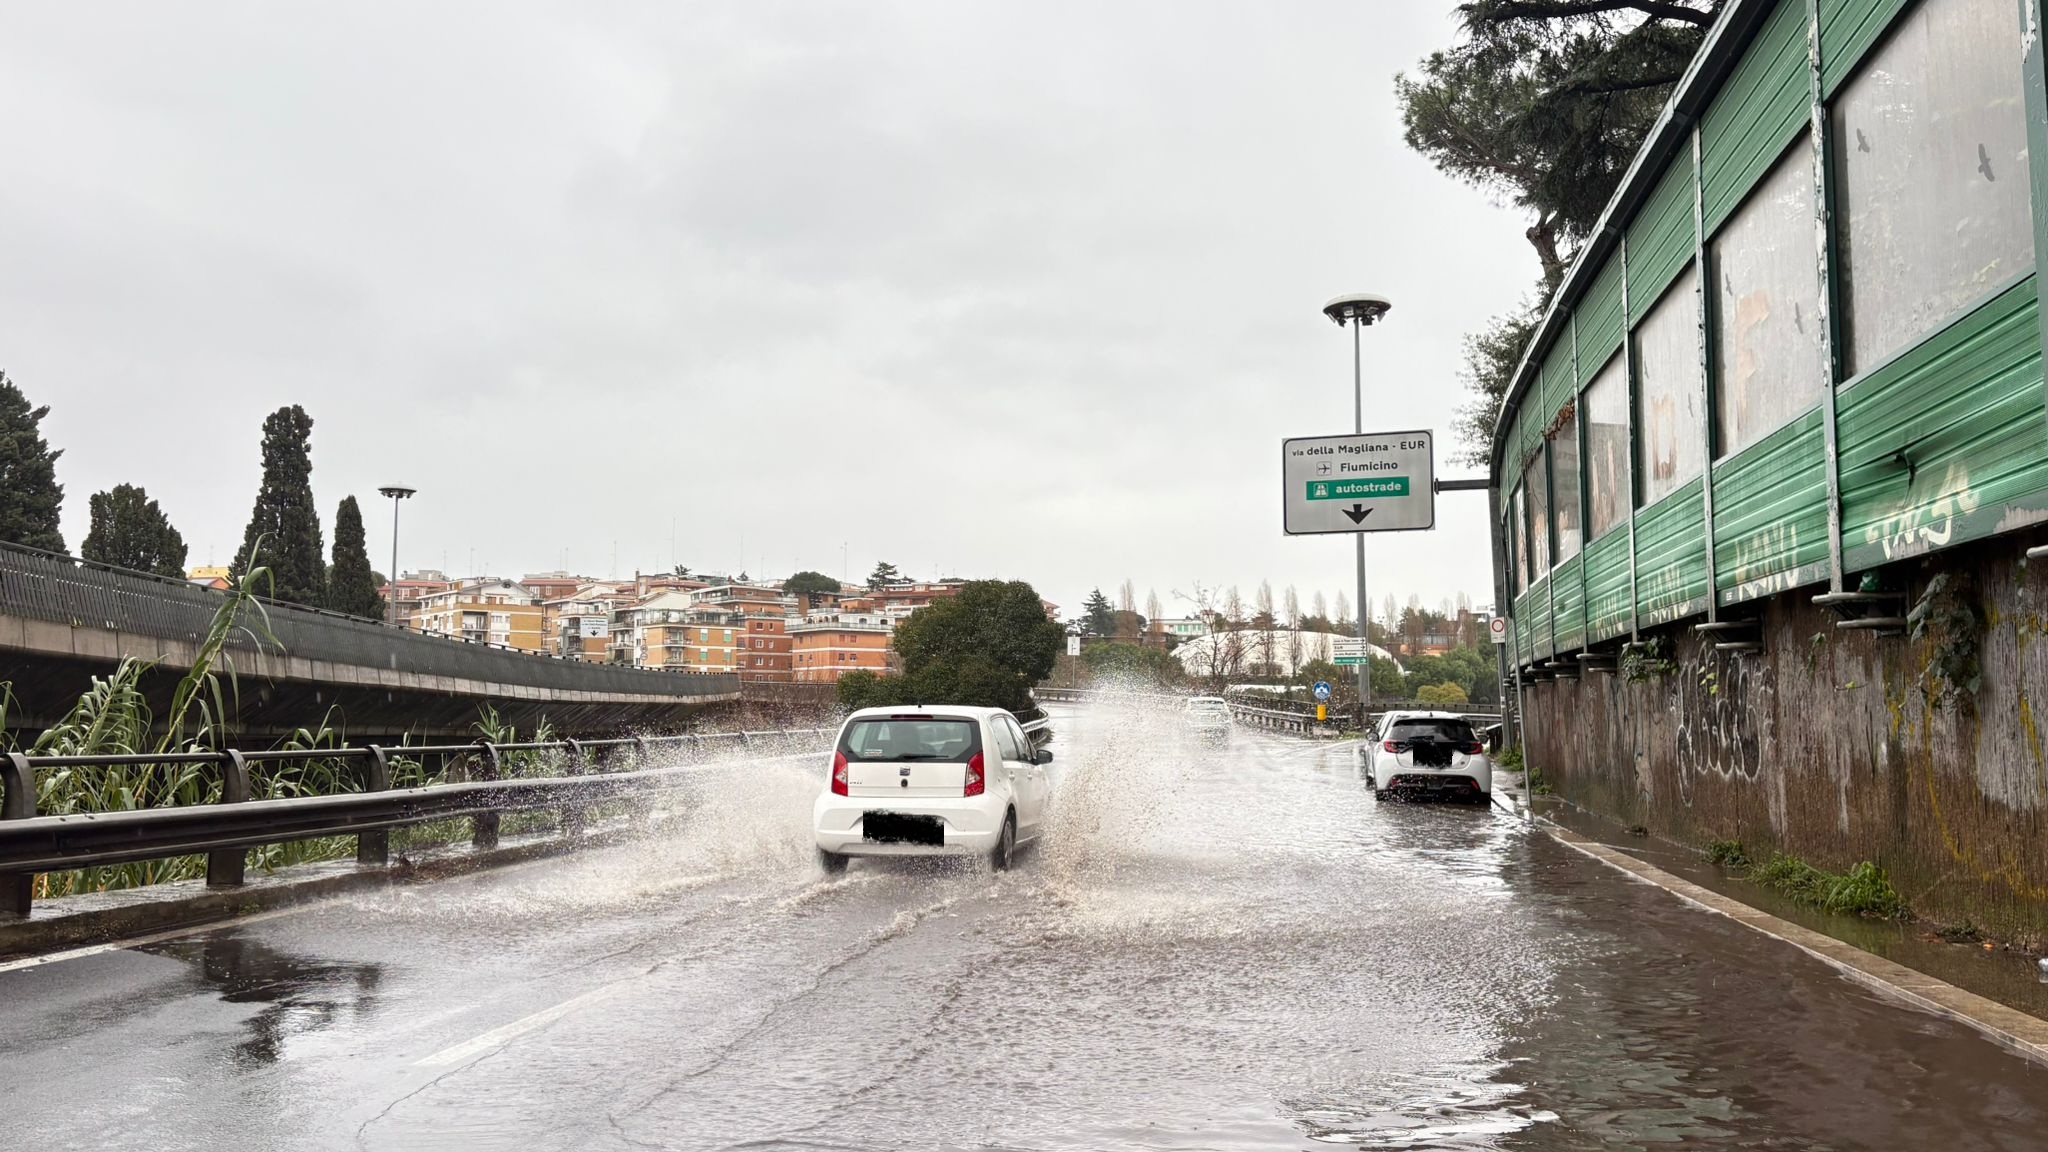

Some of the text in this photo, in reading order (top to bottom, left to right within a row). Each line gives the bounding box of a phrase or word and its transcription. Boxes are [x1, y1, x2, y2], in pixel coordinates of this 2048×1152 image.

[1307, 446, 1334, 455] della
[1338, 443, 1389, 455] Magliana
[1400, 440, 1425, 450] EUR
[1340, 461, 1398, 472] Fiumicino
[1335, 482, 1402, 493] autostrade
